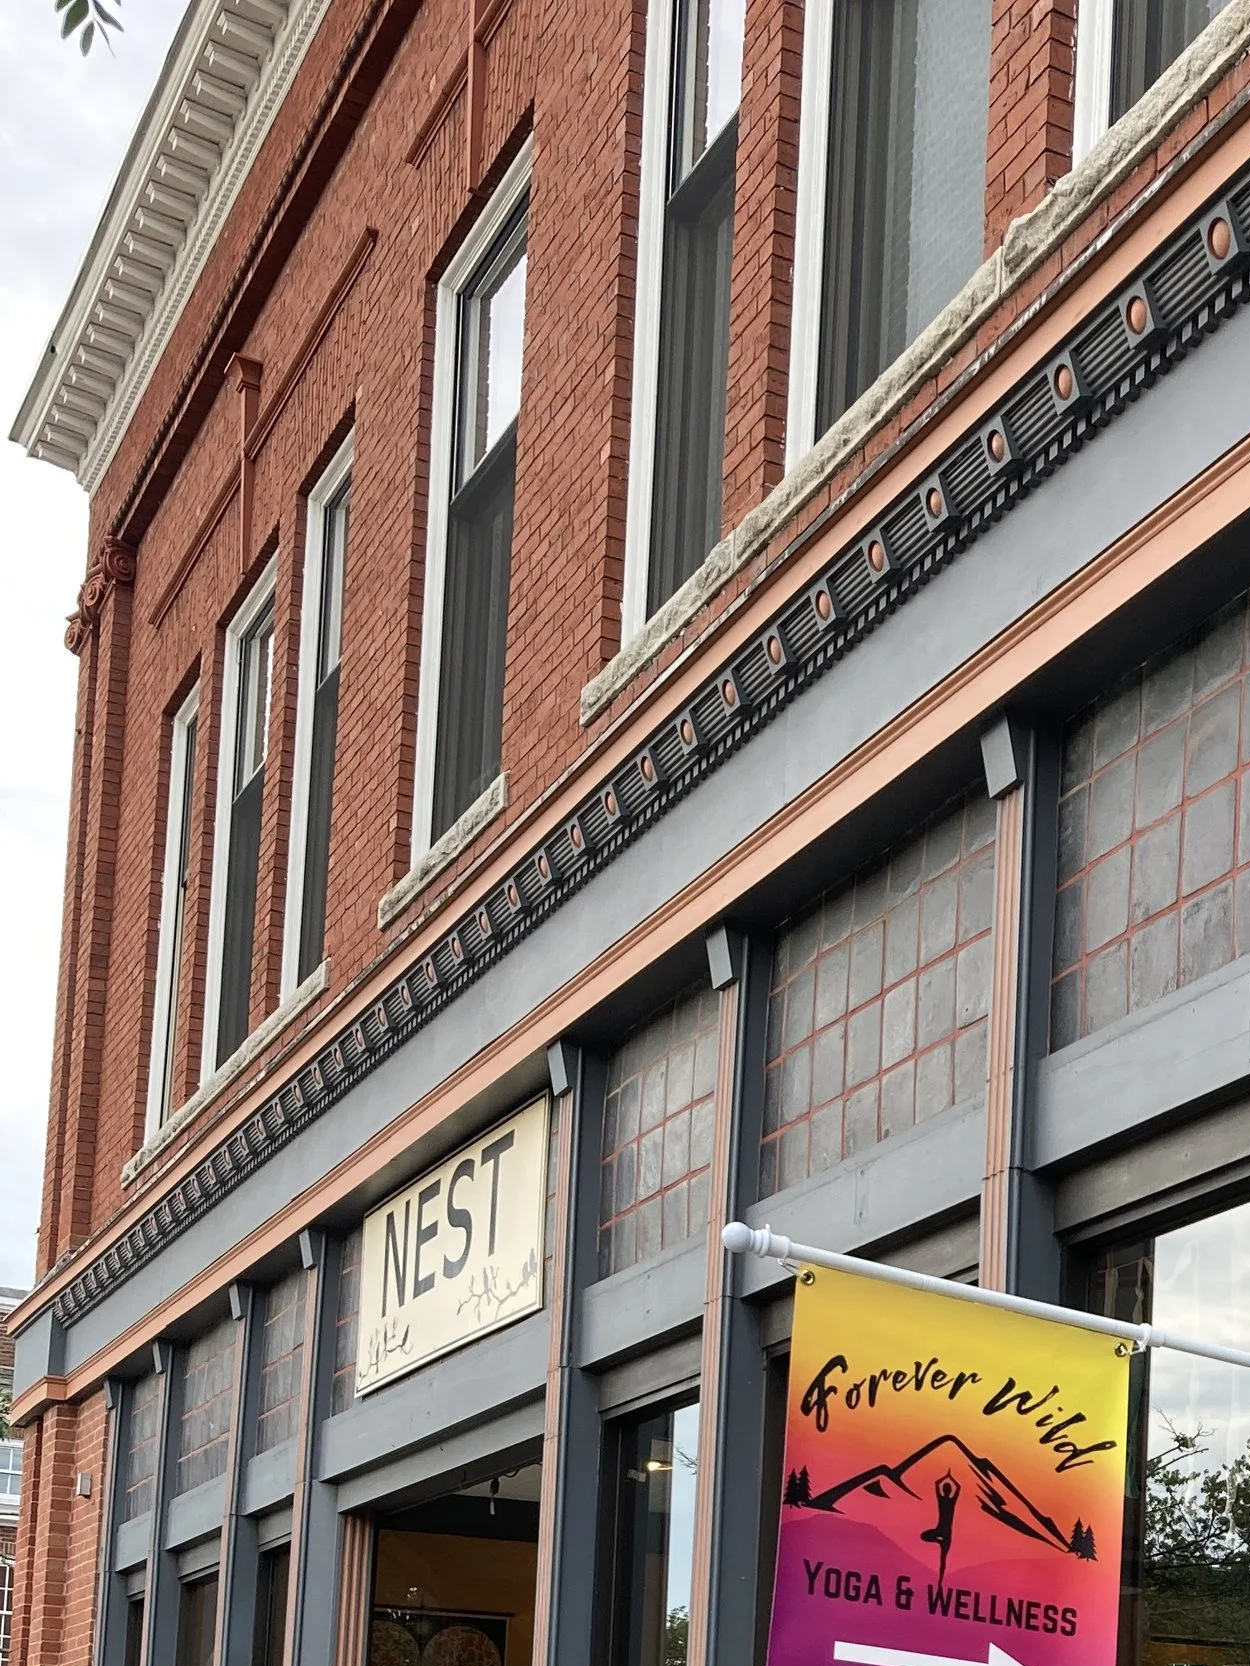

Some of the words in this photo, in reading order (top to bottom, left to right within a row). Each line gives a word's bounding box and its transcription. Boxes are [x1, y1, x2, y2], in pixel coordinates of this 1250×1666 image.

[381, 1128, 515, 1319] NEST
[983, 1377, 1117, 1474] Wild
[803, 1558, 883, 1606] YOGA
[895, 1575, 914, 1611] &
[927, 1583, 1078, 1637] WELLNESS
